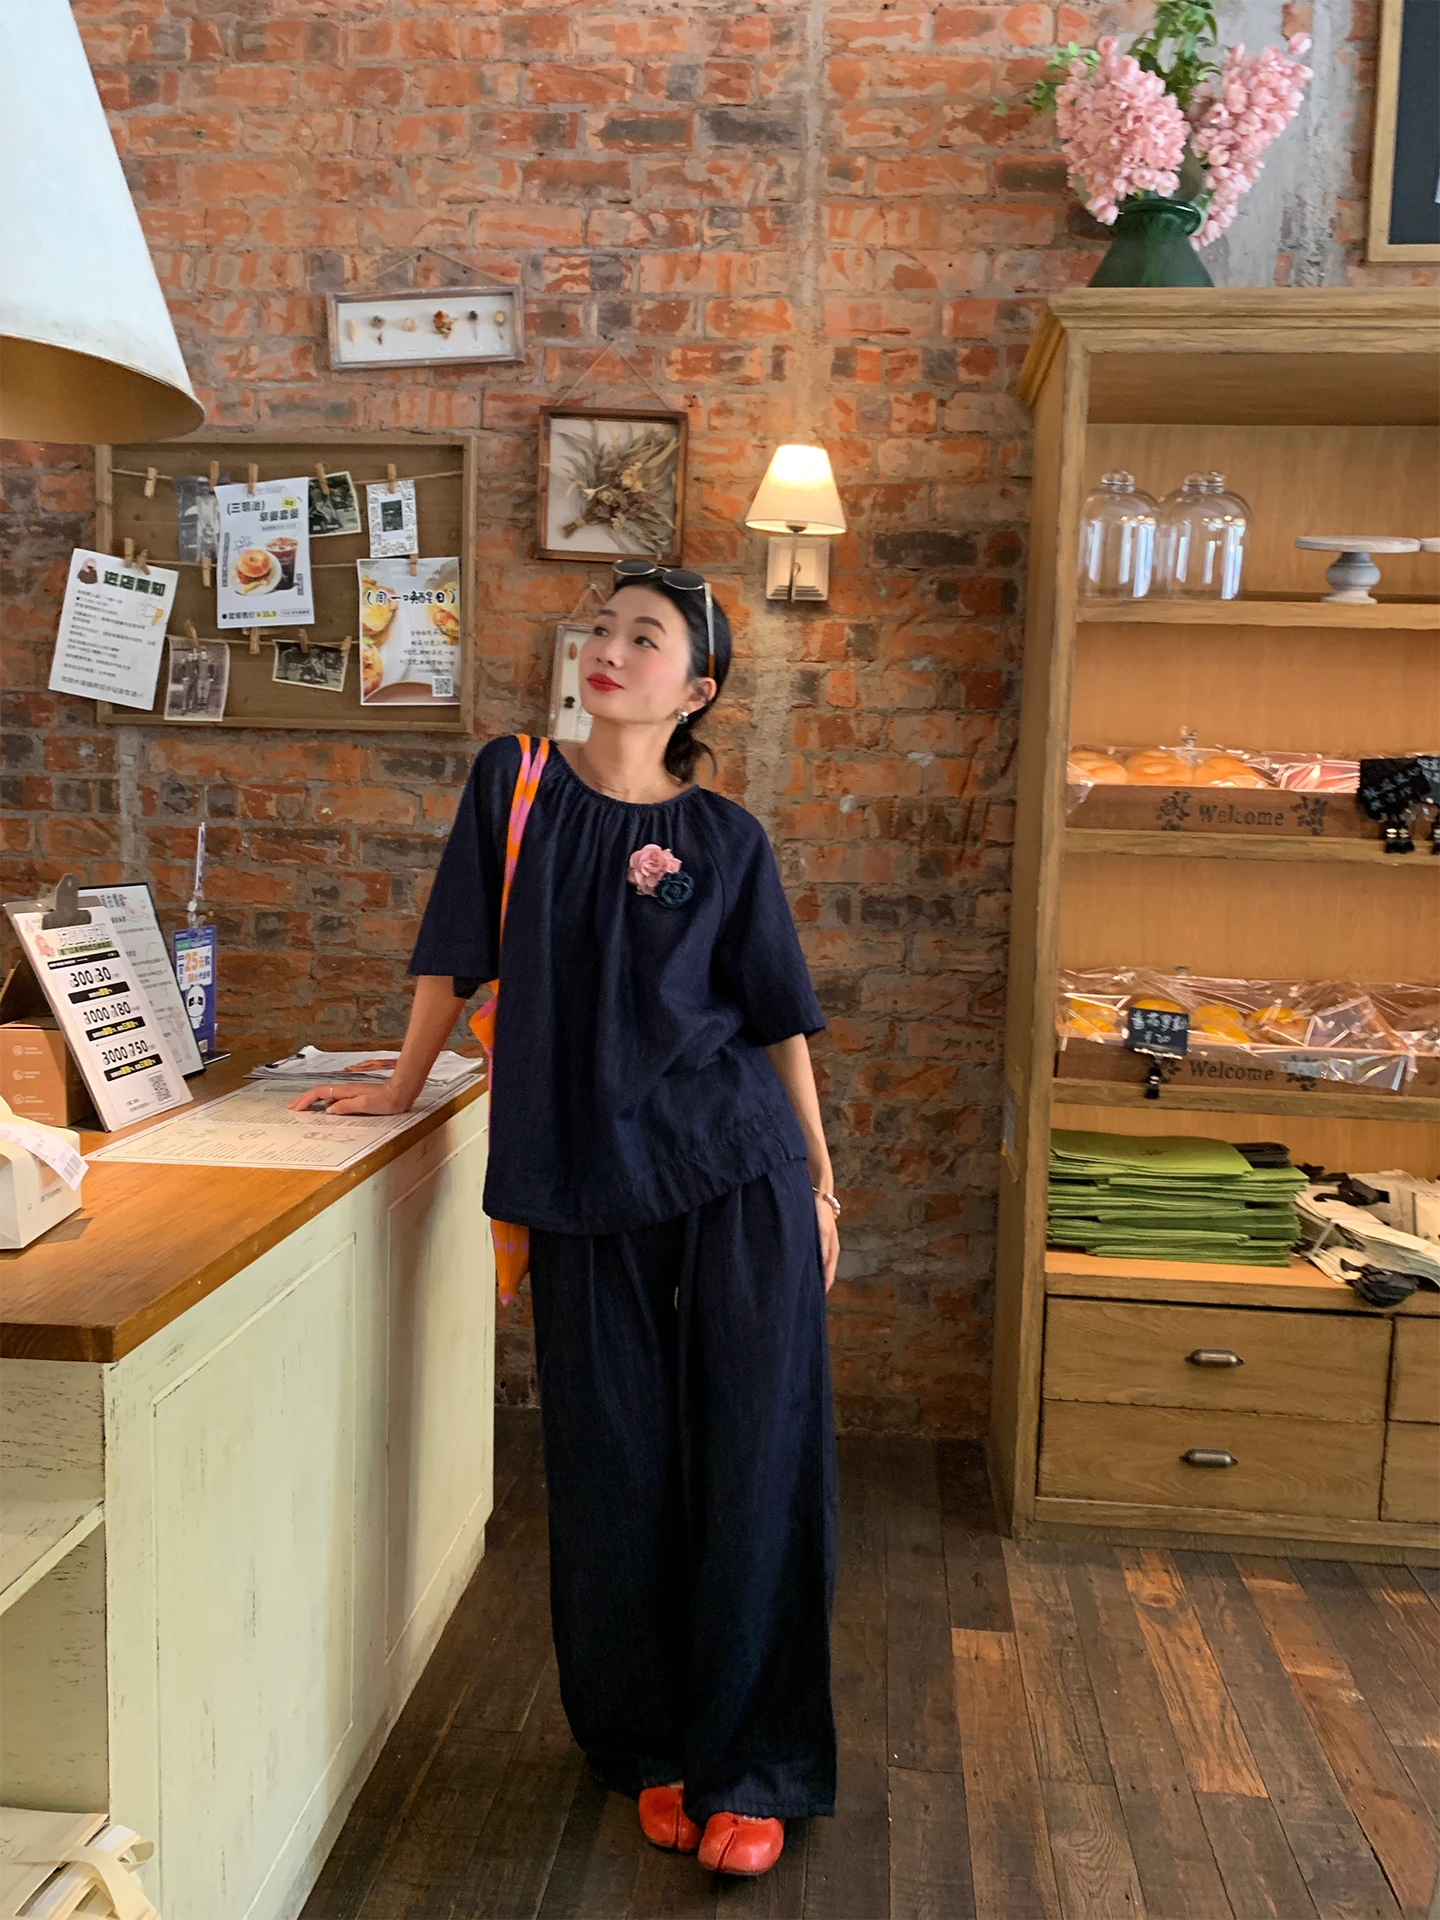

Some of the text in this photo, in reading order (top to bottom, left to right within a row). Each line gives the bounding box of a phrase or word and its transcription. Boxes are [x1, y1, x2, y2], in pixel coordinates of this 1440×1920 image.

[227, 500, 265, 515] (三明治)
[259, 508, 299, 522] 早餐套餐
[1199, 804, 1284, 826] Welcome
[70, 969, 94, 988] 300
[95, 966, 111, 983] 30
[83, 1001, 131, 1025] 1000 180
[102, 1039, 149, 1065] 3000 750
[1189, 1060, 1274, 1081] Welcome
